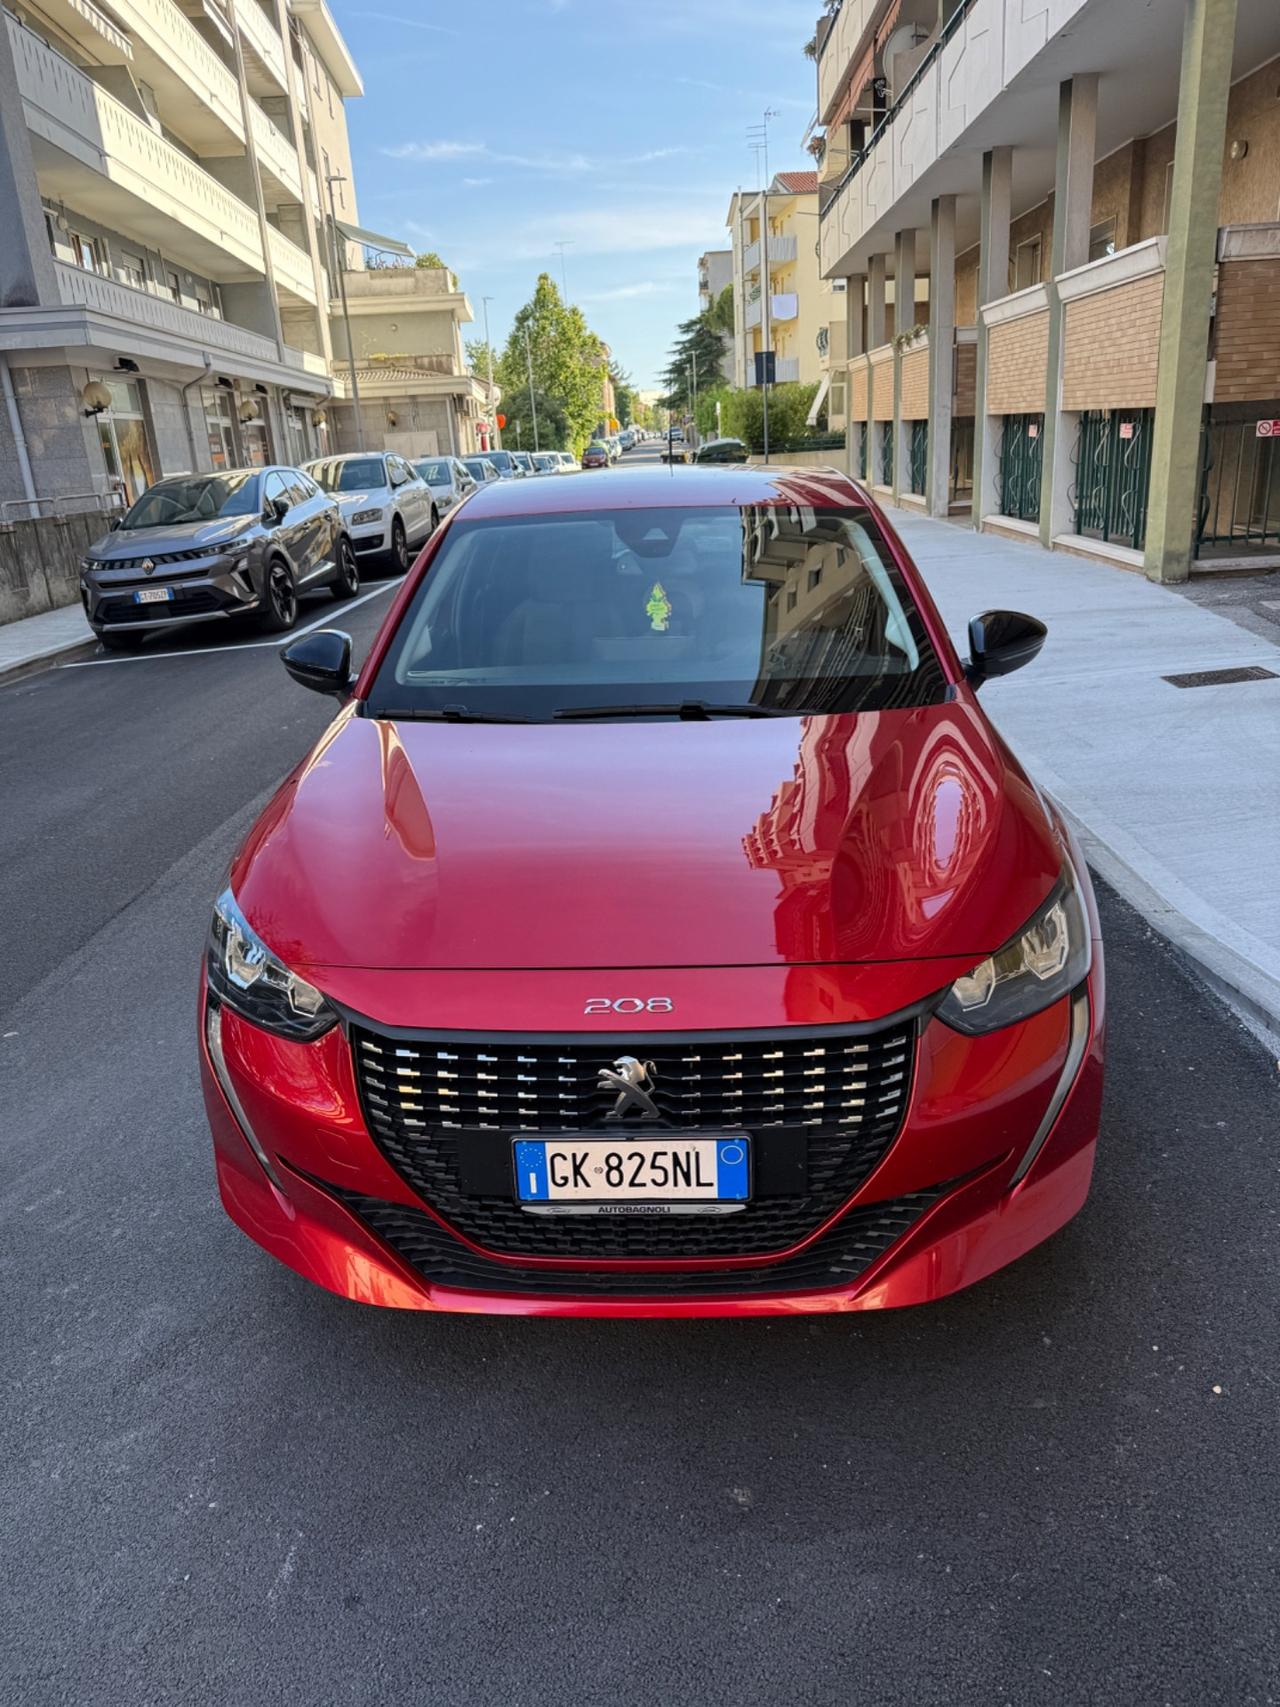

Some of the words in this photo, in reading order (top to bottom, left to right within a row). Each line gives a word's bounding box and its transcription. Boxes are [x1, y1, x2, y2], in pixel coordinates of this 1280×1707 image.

[584, 997, 673, 1014] 208
[549, 1152, 591, 1188] GK
[604, 1151, 714, 1187] 825NL
